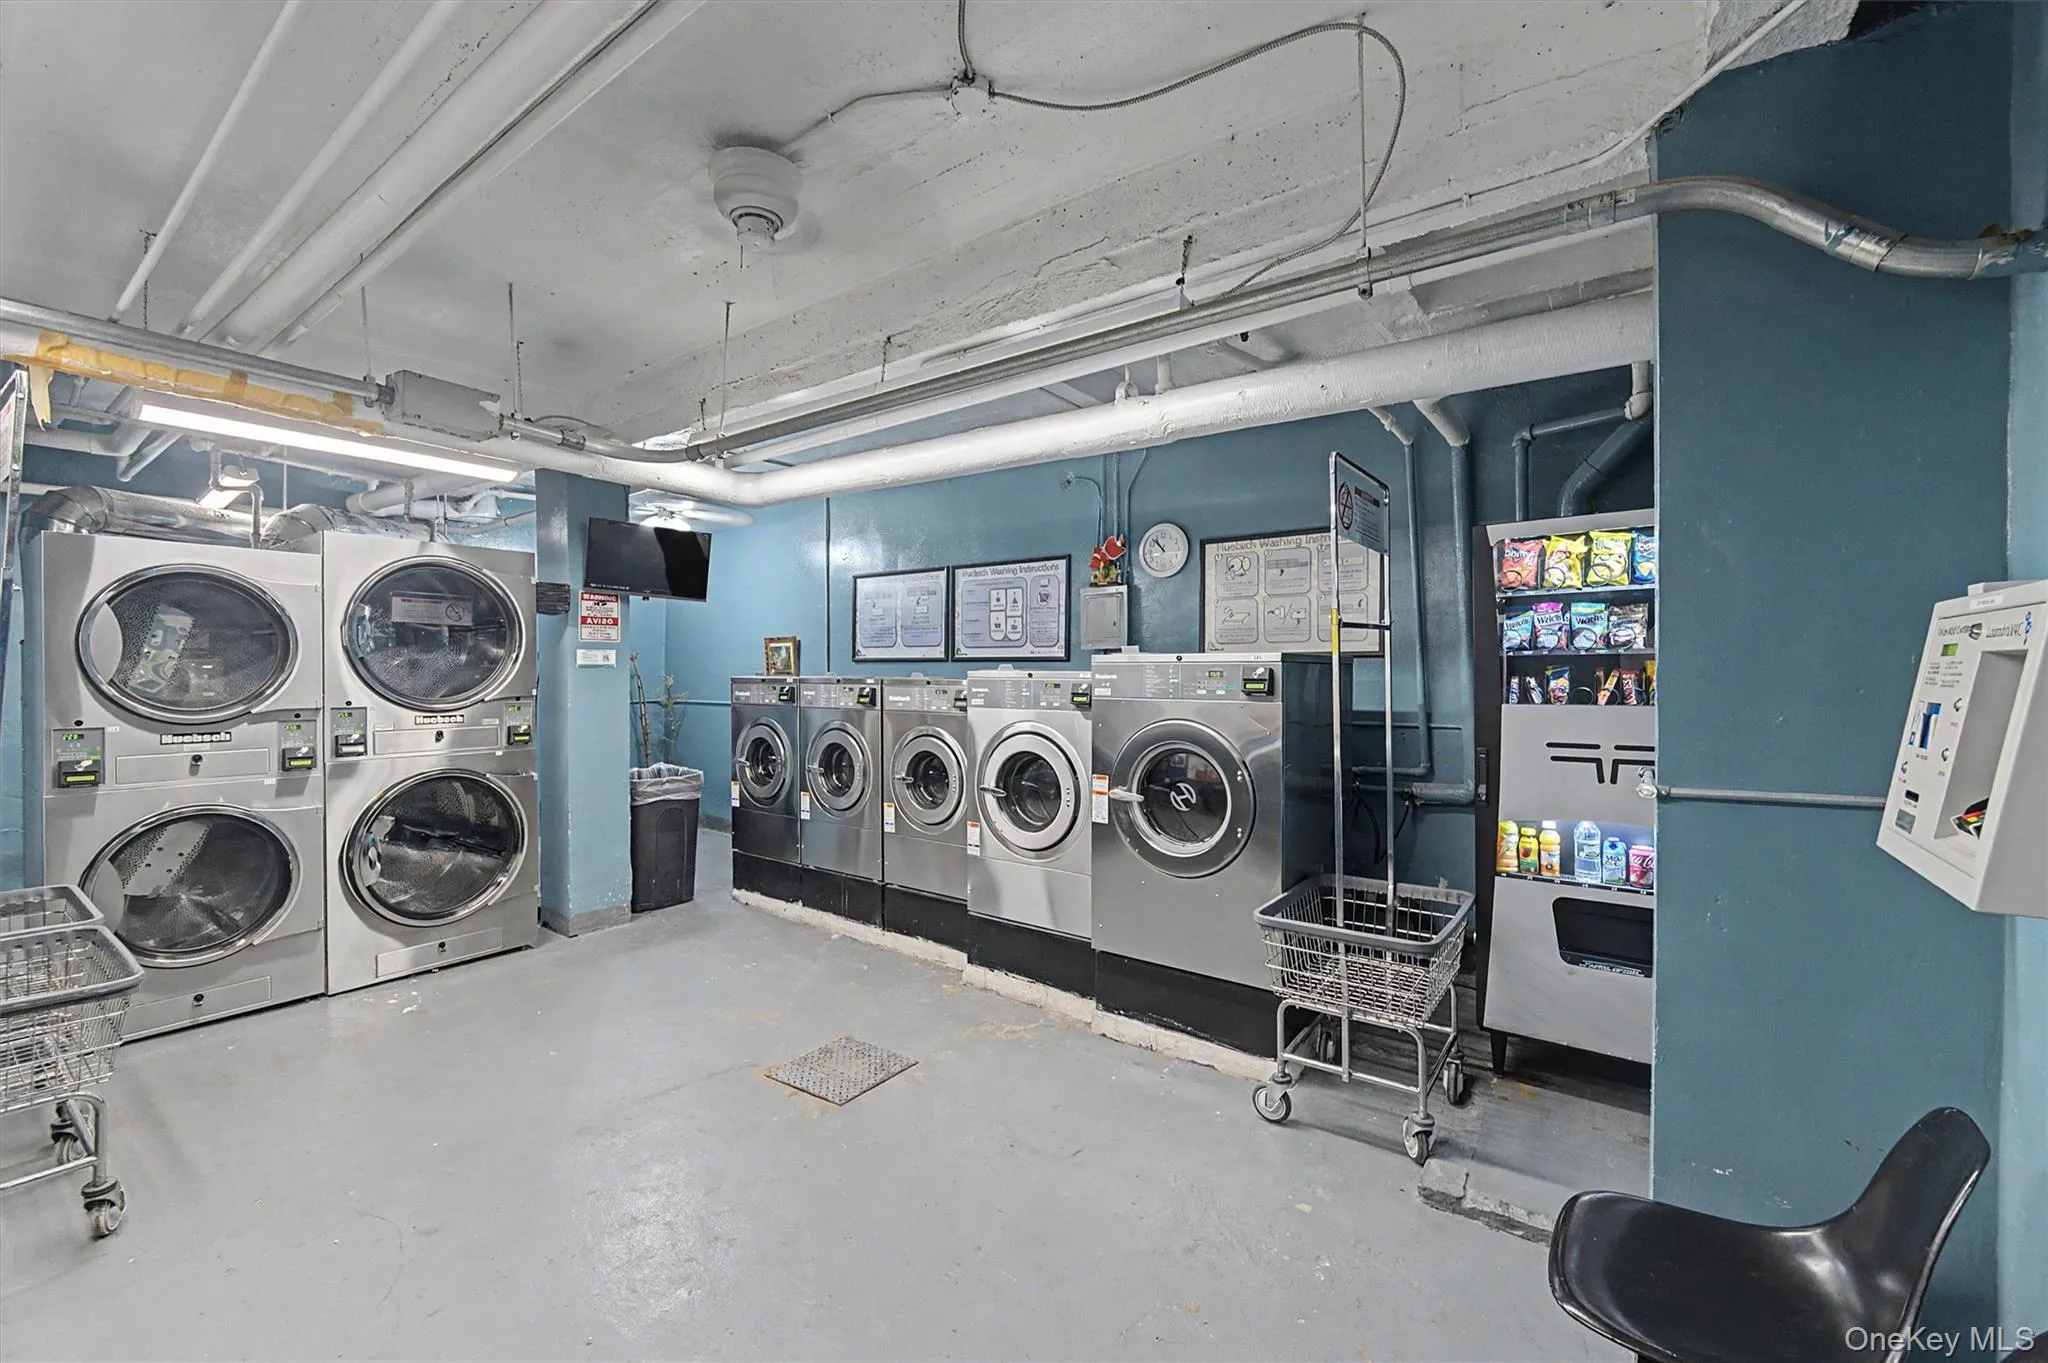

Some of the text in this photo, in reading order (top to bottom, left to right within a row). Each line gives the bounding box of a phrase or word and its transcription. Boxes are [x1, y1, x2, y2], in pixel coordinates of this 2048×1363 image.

[1260, 537, 1302, 549] Washing
[582, 593, 617, 602] WARNING
[586, 617, 614, 625] AVISO
